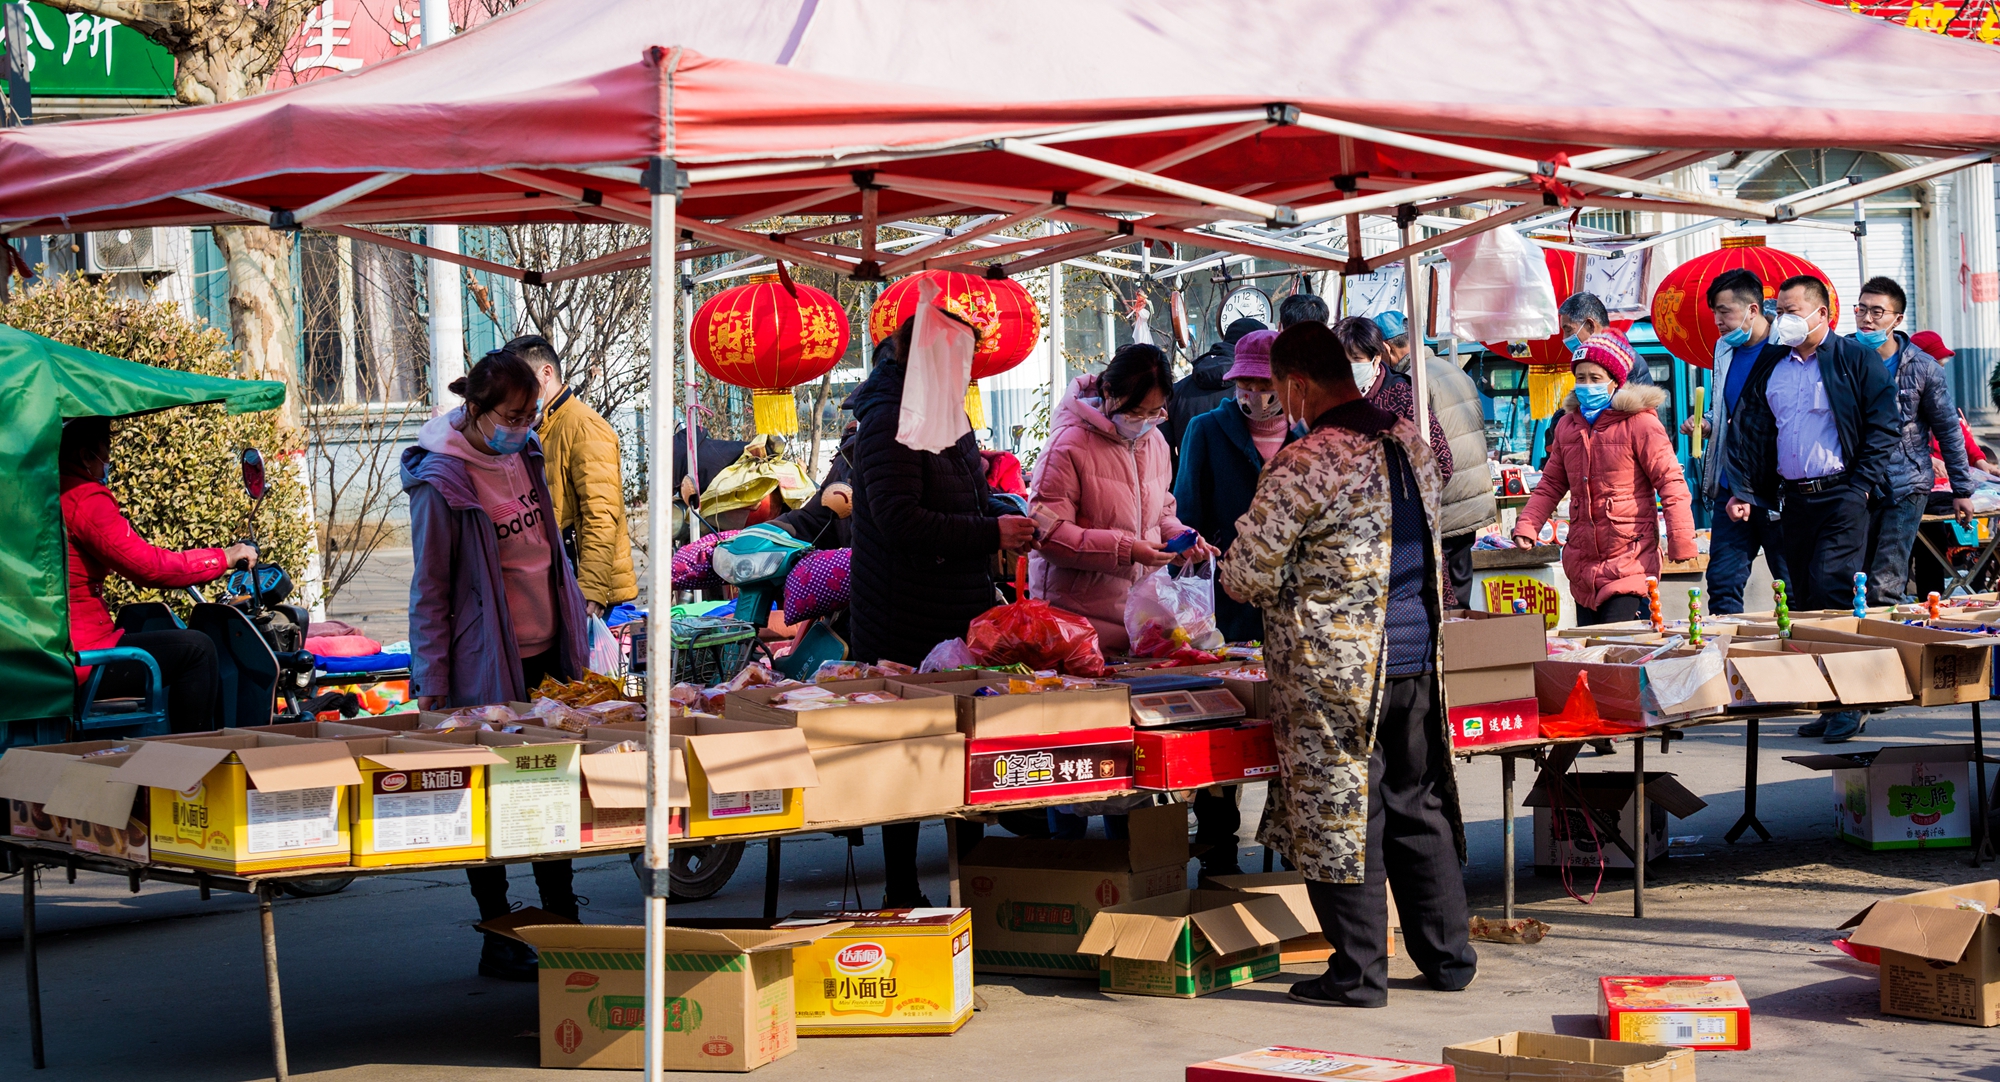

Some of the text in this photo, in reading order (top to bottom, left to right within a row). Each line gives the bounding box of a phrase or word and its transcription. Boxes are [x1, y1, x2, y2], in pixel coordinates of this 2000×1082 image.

[1369, 272, 1378, 281] 12
[1392, 278, 1399, 287] 2
[1234, 295, 1240, 303] 11
[1242, 292, 1251, 300] 12
[1390, 296, 1397, 305] 3
[1225, 303, 1233, 312] 10
[1259, 304, 1265, 312] 2
[1222, 314, 1227, 322] 9
[716, 320, 745, 352] 財
[1489, 714, 1523, 732] 送健康
[516, 754, 557, 770] 瑞士卷
[1058, 758, 1093, 781] 枣糕
[421, 770, 464, 789] 软面包
[180, 802, 209, 829] 小面包
[838, 977, 898, 999] 小面包
